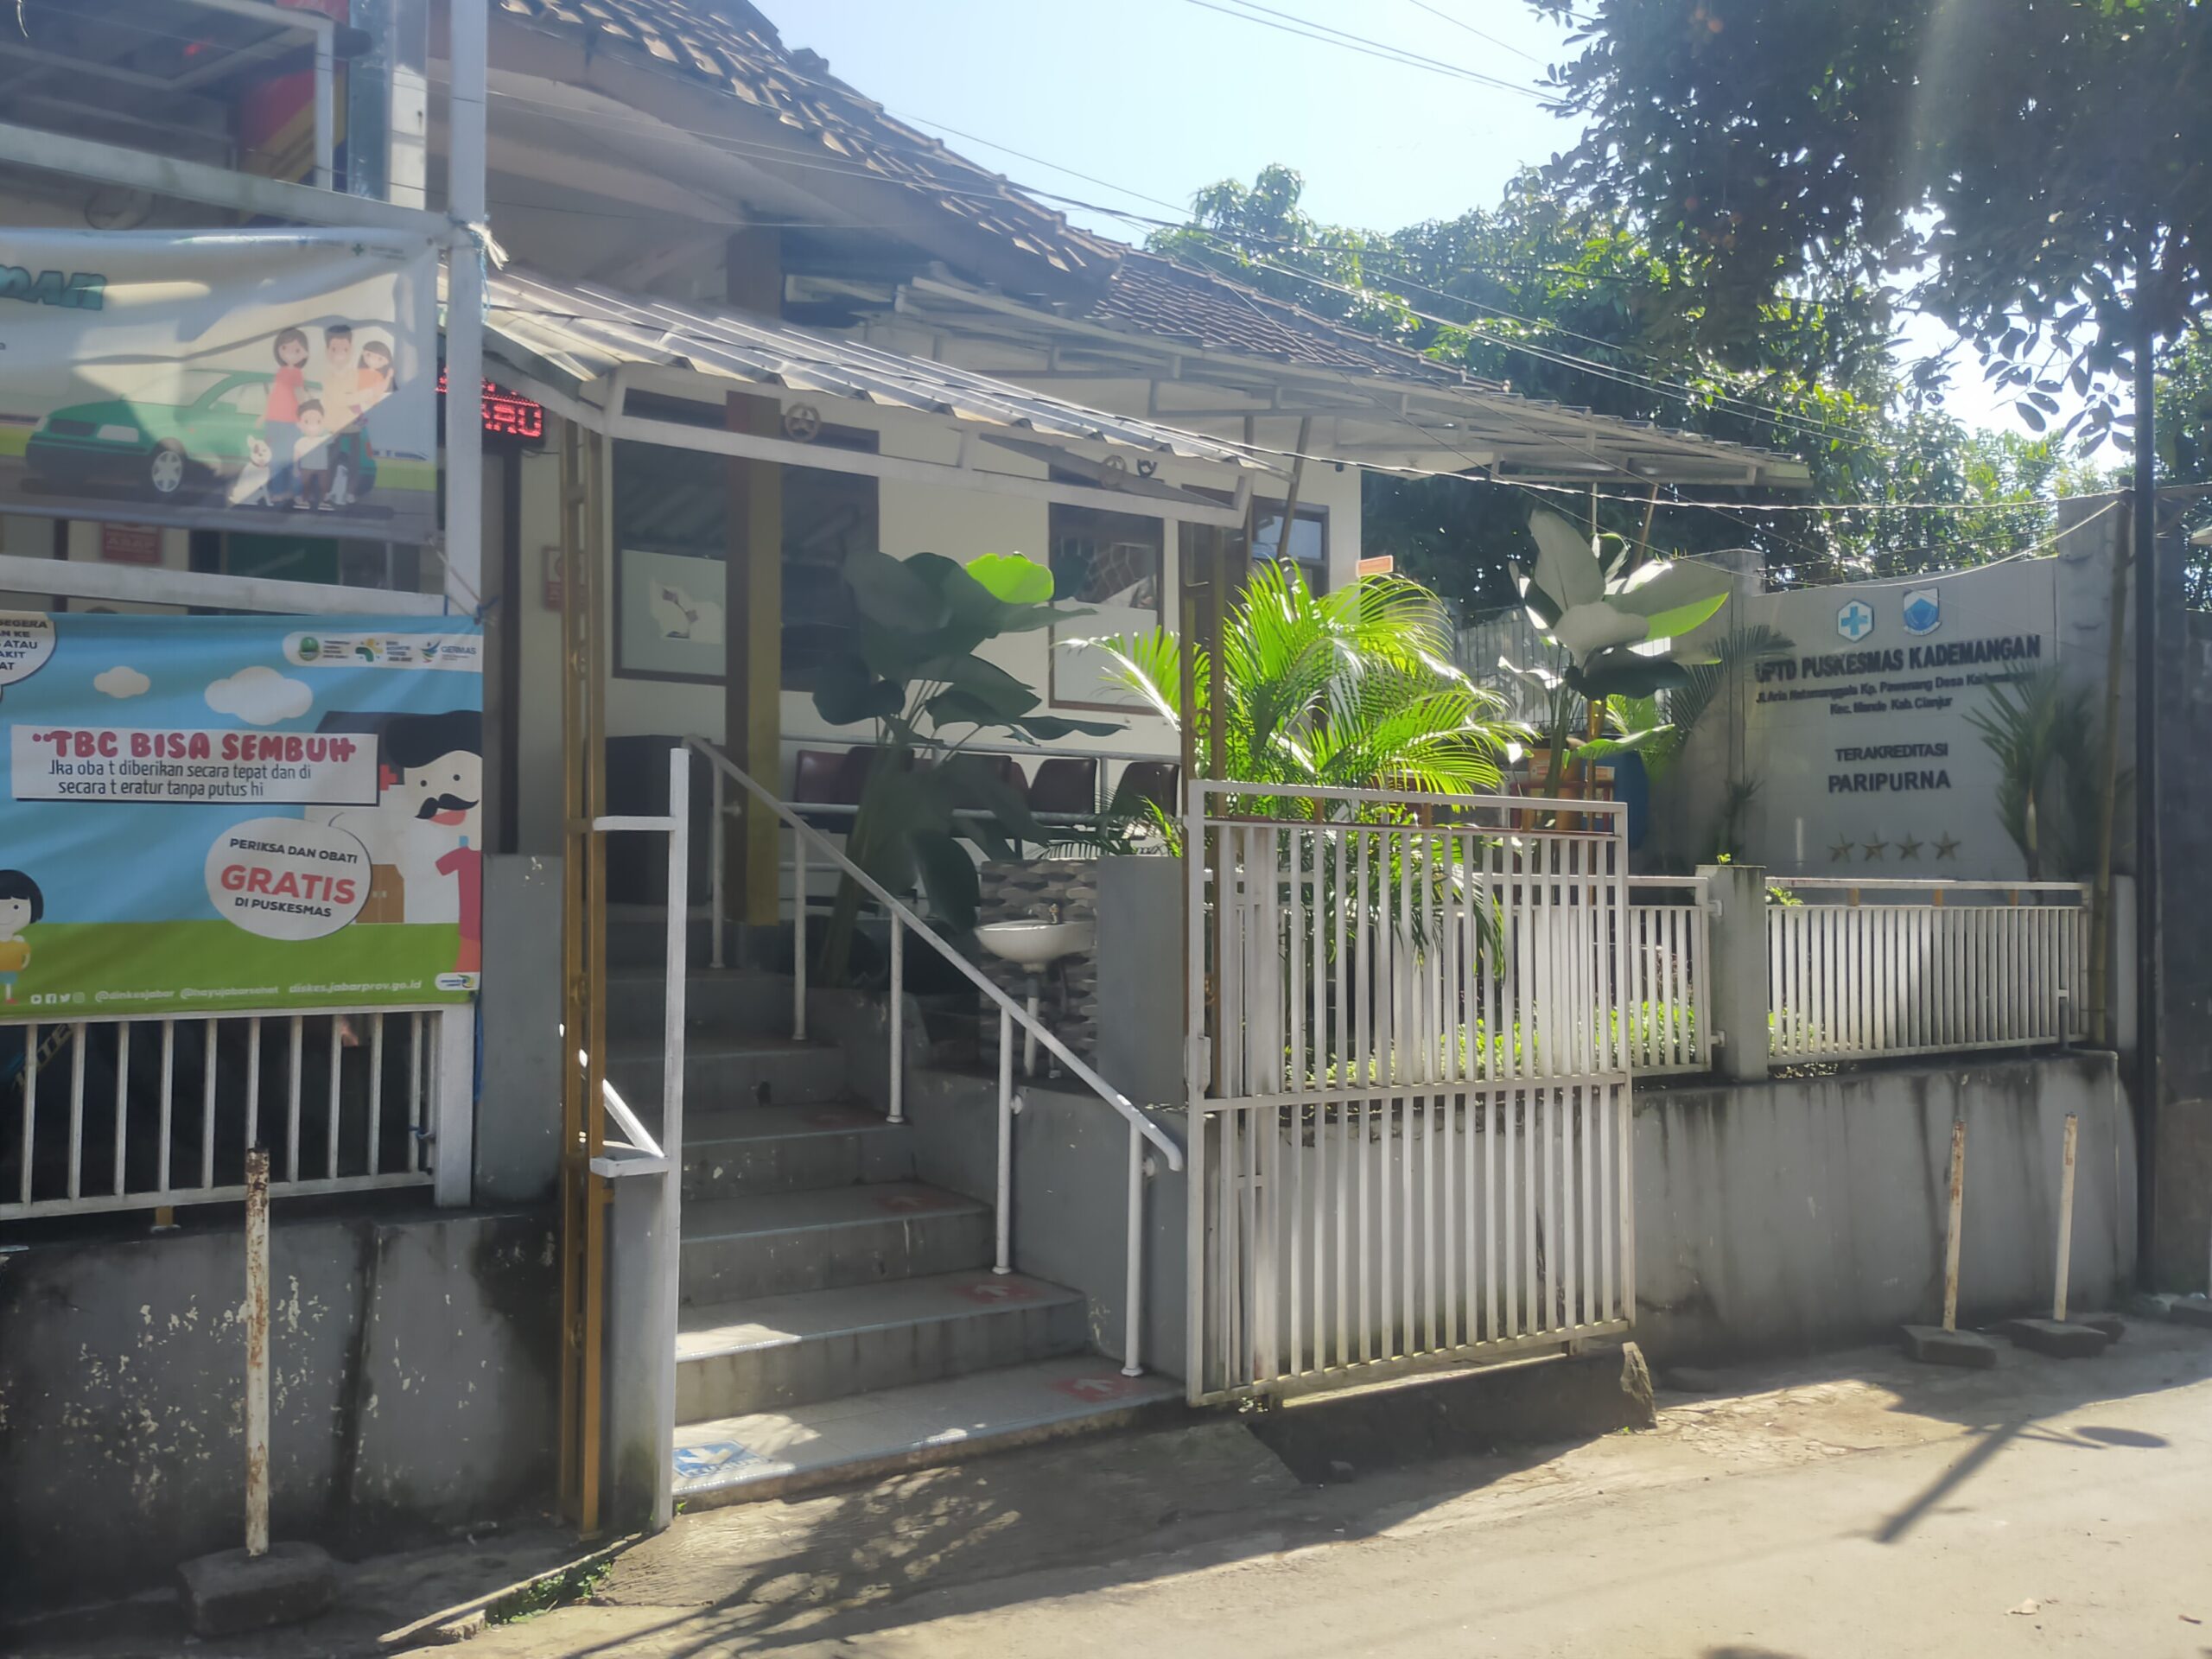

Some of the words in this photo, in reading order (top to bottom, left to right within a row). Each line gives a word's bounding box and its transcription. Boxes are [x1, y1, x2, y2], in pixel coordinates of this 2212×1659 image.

[3, 639, 38, 650] ATAU
[1754, 658, 1797, 683] UPTD
[1802, 647, 1904, 679] PUSKESMAS
[1909, 633, 2042, 670] KADEMANGAN
[1936, 676, 1964, 689] Desa
[130, 732, 211, 760] BISA
[221, 734, 353, 762] SEMBUH
[1834, 742, 1949, 762] TERAKREDITASI
[119, 760, 183, 778] diberikan
[187, 766, 229, 779] secara
[233, 764, 268, 782] tepat
[271, 765, 296, 779] dan
[299, 764, 312, 779] di
[1828, 769, 1952, 794] PARIPURNA
[58, 781, 106, 794] secara
[120, 780, 163, 795] eratur
[168, 779, 205, 799] tanpa
[208, 781, 248, 799] putus
[251, 781, 264, 797] hi
[230, 838, 285, 855] PERIKSA
[288, 846, 316, 858] DAN
[319, 849, 358, 864] OBATI
[220, 864, 357, 905] GRATIS
[235, 897, 248, 908] DI
[251, 899, 332, 918] PUSKESMAS
